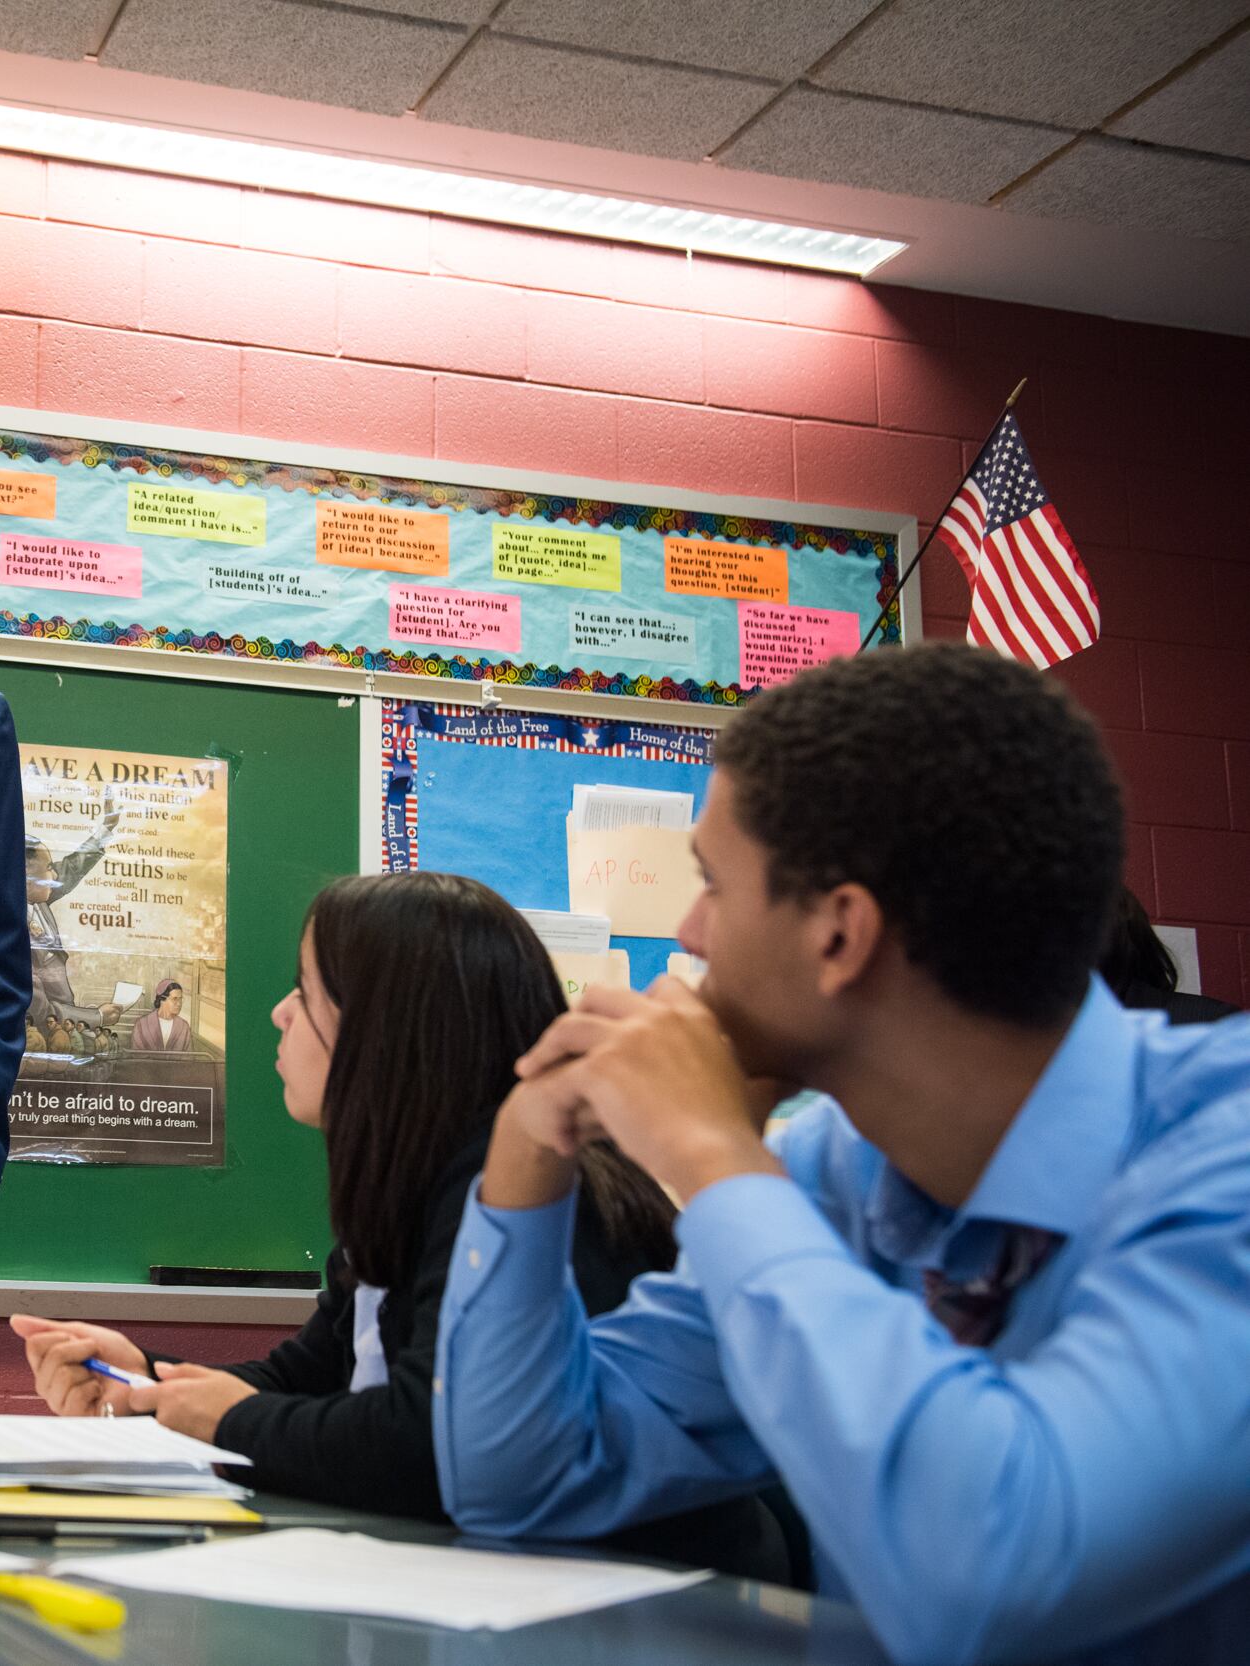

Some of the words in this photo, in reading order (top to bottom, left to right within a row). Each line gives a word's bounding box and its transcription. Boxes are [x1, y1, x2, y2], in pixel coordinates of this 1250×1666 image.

[17, 487, 38, 495] see
[152, 492, 195, 504] related
[133, 514, 187, 527] comment
[191, 520, 196, 528] I
[200, 520, 227, 531] have
[341, 511, 375, 522] would
[378, 514, 400, 525] like
[403, 517, 415, 527] to
[322, 520, 359, 531] return
[363, 522, 375, 532] to
[379, 526, 399, 536] our
[322, 531, 371, 544] previous
[375, 536, 436, 552] discussion
[502, 531, 534, 543] “Your
[538, 536, 587, 548] comment
[21, 543, 58, 555] would
[62, 546, 85, 558] like
[88, 549, 102, 559] to
[322, 542, 334, 551] of
[338, 543, 375, 557] [idea]
[498, 553, 510, 562] of
[543, 547, 588, 559] reminds
[591, 553, 607, 562] me
[697, 548, 750, 561] interested
[754, 553, 764, 563] in
[5, 553, 64, 567] elaborate
[68, 560, 99, 571] upon
[498, 563, 513, 573] On
[670, 555, 711, 569] hearing
[715, 561, 739, 571] your
[208, 566, 264, 582] “Building
[268, 573, 285, 583] off
[289, 575, 301, 584] of
[670, 566, 718, 579] thoughts
[721, 572, 735, 581] on
[738, 573, 758, 583] this
[395, 603, 444, 615] question
[448, 607, 465, 617] for
[414, 592, 440, 603] have
[454, 597, 508, 613] clarifying
[396, 612, 455, 628] [student].
[458, 620, 478, 630] Are
[481, 623, 501, 633] you
[590, 613, 611, 624] can
[615, 617, 635, 626] see
[769, 610, 786, 621] far
[806, 615, 830, 625] have
[395, 625, 432, 638] saying
[575, 623, 627, 638] however,
[631, 628, 636, 637] I
[640, 629, 689, 643] disagree
[744, 620, 796, 632] discussed
[745, 642, 776, 651] would
[780, 644, 799, 654] like
[803, 647, 814, 656] to
[820, 637, 825, 646] I
[745, 652, 798, 665] transition
[802, 658, 814, 666] us
[745, 664, 766, 673] new
[444, 719, 477, 736] Land
[480, 719, 495, 736] of
[496, 718, 518, 735] the
[520, 717, 550, 733] Free
[629, 726, 667, 747] Home
[669, 735, 684, 751] of
[684, 738, 704, 756] the
[23, 756, 78, 780] AVE
[85, 761, 105, 782] A
[111, 762, 216, 791] DREAM
[149, 790, 193, 806] nation
[39, 794, 73, 814] rise
[79, 801, 102, 821] up
[126, 810, 143, 819] and
[145, 806, 169, 821] live
[170, 814, 185, 822] out
[32, 820, 44, 828] the
[387, 803, 404, 839] Land
[109, 843, 135, 855] “We
[137, 844, 163, 858] hold
[166, 847, 196, 860] these
[390, 841, 407, 857] of
[103, 858, 164, 880] truths
[166, 872, 175, 881] to
[177, 872, 188, 881] be
[392, 858, 409, 874] th
[84, 876, 138, 890] self-evident,
[130, 889, 149, 903] all
[153, 893, 184, 905] men
[69, 901, 84, 911] are
[86, 902, 122, 913] created
[8, 1091, 33, 1108] n’t
[38, 1092, 60, 1109] be
[65, 1093, 114, 1111] afraid
[119, 1095, 135, 1112] to
[140, 1096, 199, 1115] dream.
[18, 1111, 41, 1125] truly
[42, 1113, 70, 1125] great
[71, 1113, 96, 1126] thing
[98, 1114, 131, 1127] begins
[132, 1116, 153, 1127] with
[155, 1119, 162, 1127] a
[164, 1118, 199, 1129] dream.
